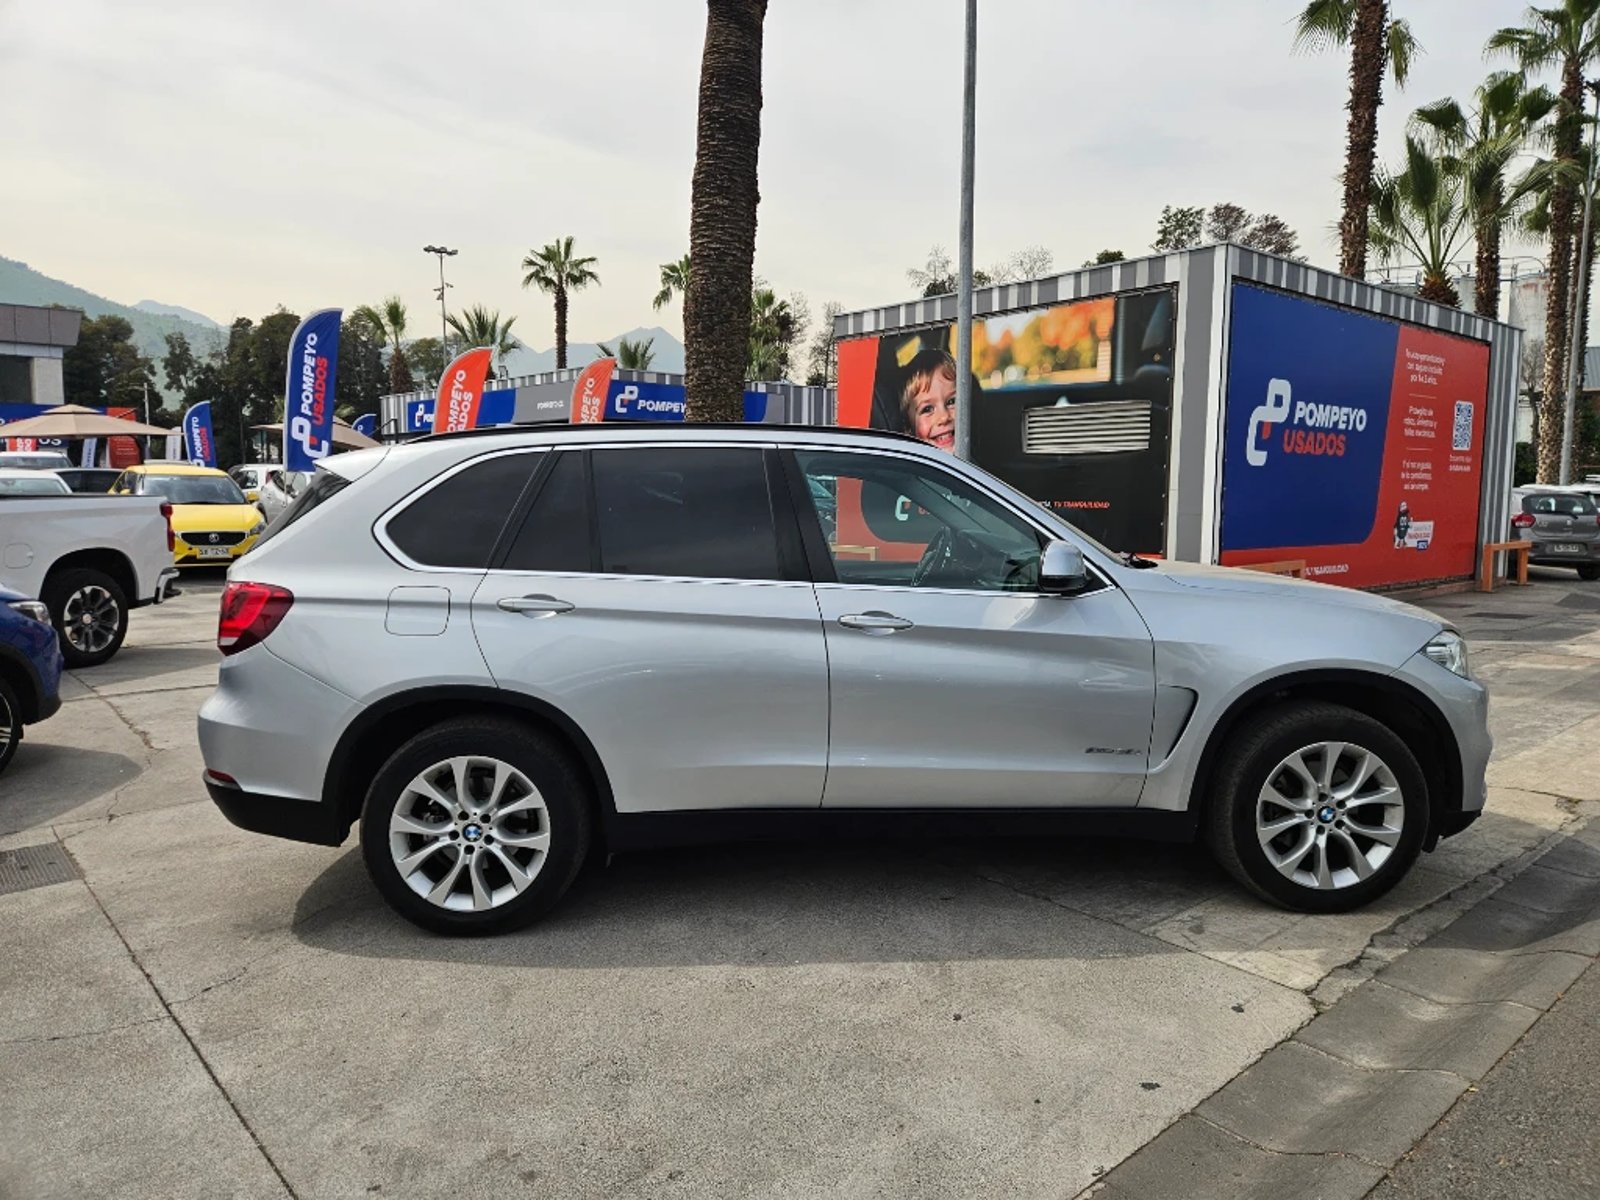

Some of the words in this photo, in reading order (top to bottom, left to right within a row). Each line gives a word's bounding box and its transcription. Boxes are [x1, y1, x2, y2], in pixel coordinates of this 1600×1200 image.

[301, 332, 318, 416] POMPEYO
[312, 356, 328, 426] USADOS
[447, 369, 467, 432] OMPEYO
[581, 377, 595, 423] MPEYO
[637, 399, 686, 413] POMPEY
[1293, 401, 1367, 432] POMPEYO
[1282, 428, 1346, 456] USADOS
